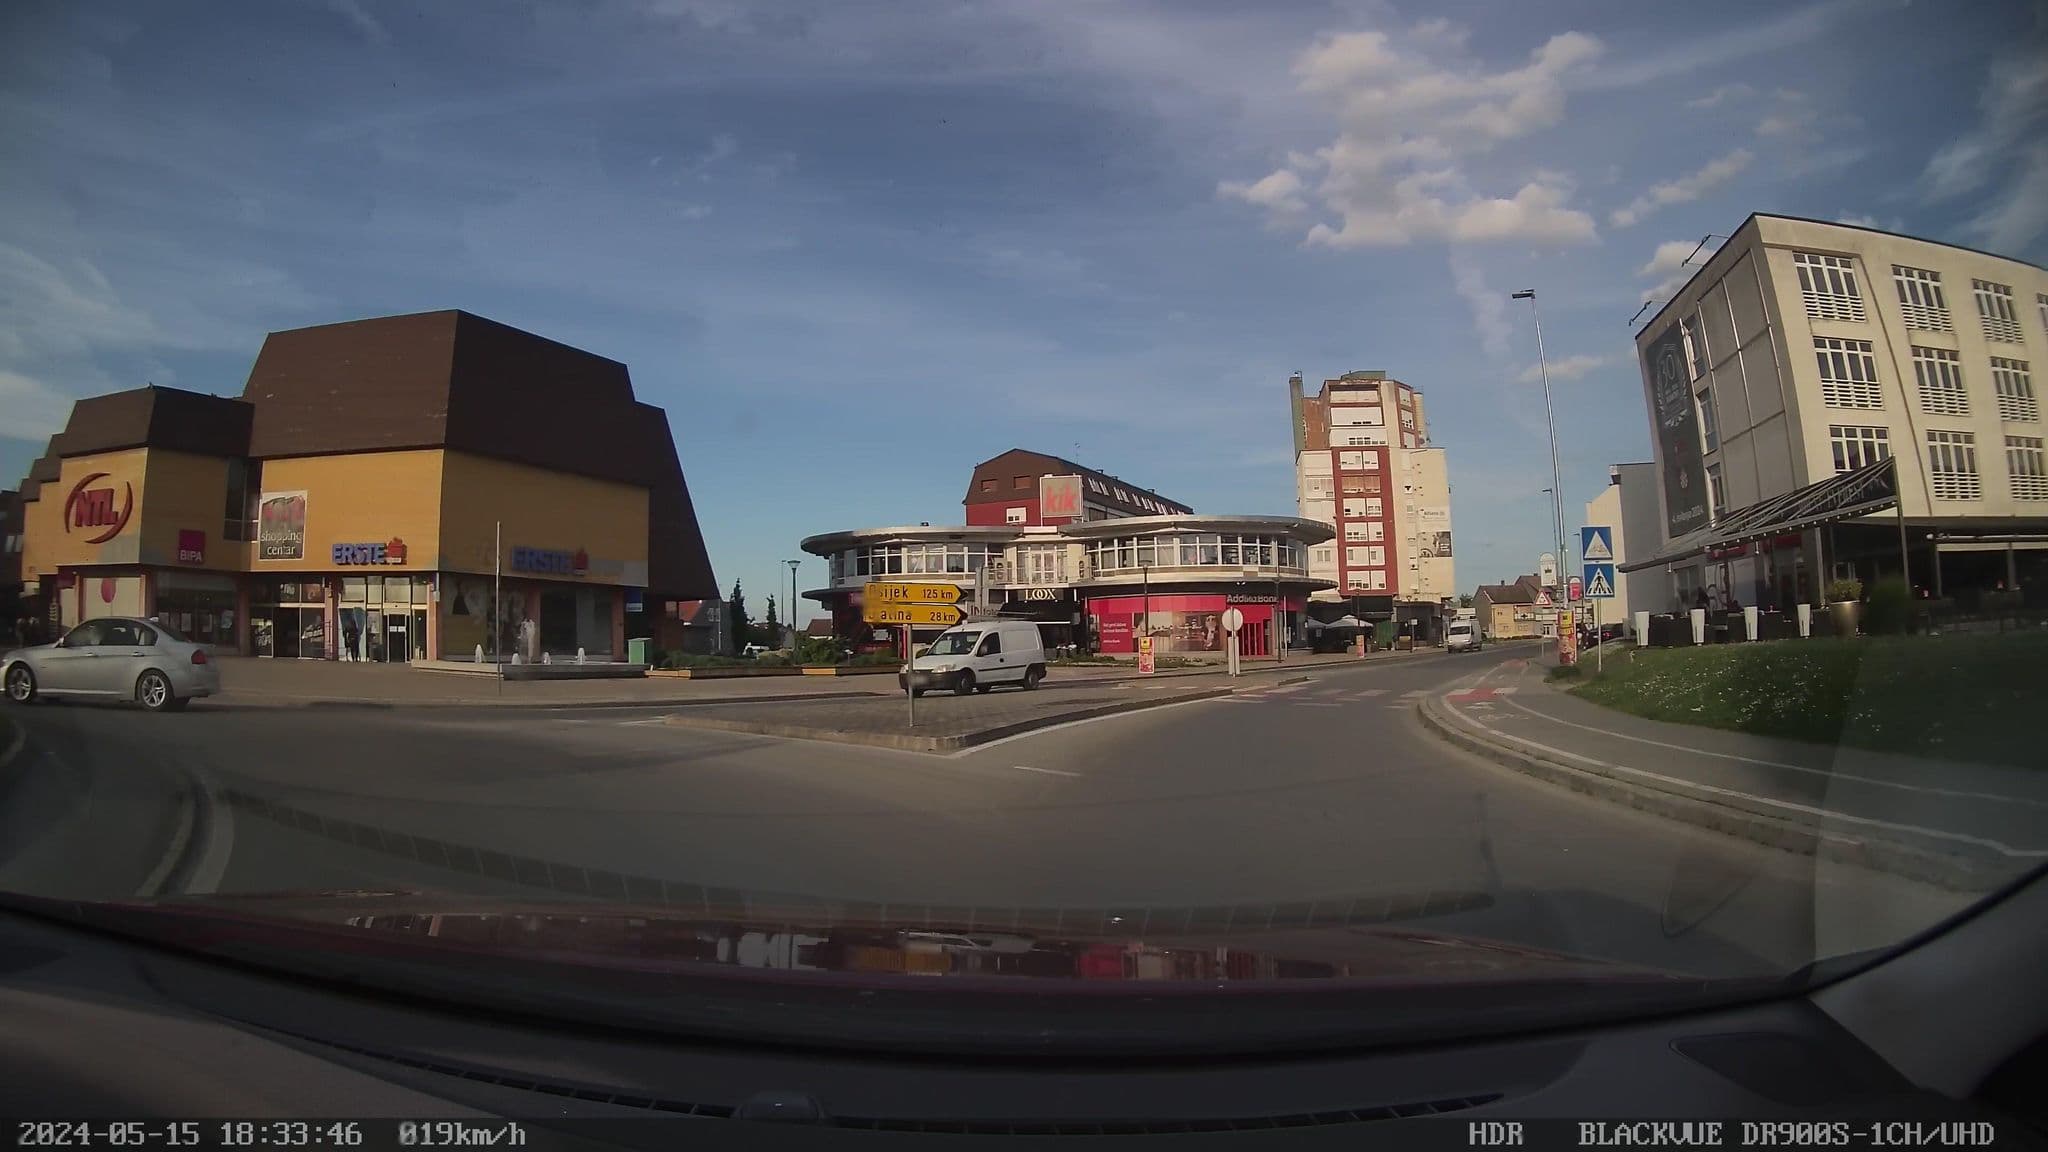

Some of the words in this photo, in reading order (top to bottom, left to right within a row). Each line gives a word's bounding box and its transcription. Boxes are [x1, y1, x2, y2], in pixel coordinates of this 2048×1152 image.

[75, 488, 118, 527] NTL
[260, 530, 302, 543] shopping
[179, 549, 202, 562] BIPA
[332, 543, 387, 564] ERSTE
[512, 549, 571, 572] ERSTE
[922, 588, 938, 599] 125
[941, 590, 953, 599] km
[1025, 589, 1056, 600] LOOX
[930, 611, 941, 620] 28
[943, 612, 956, 621] km
